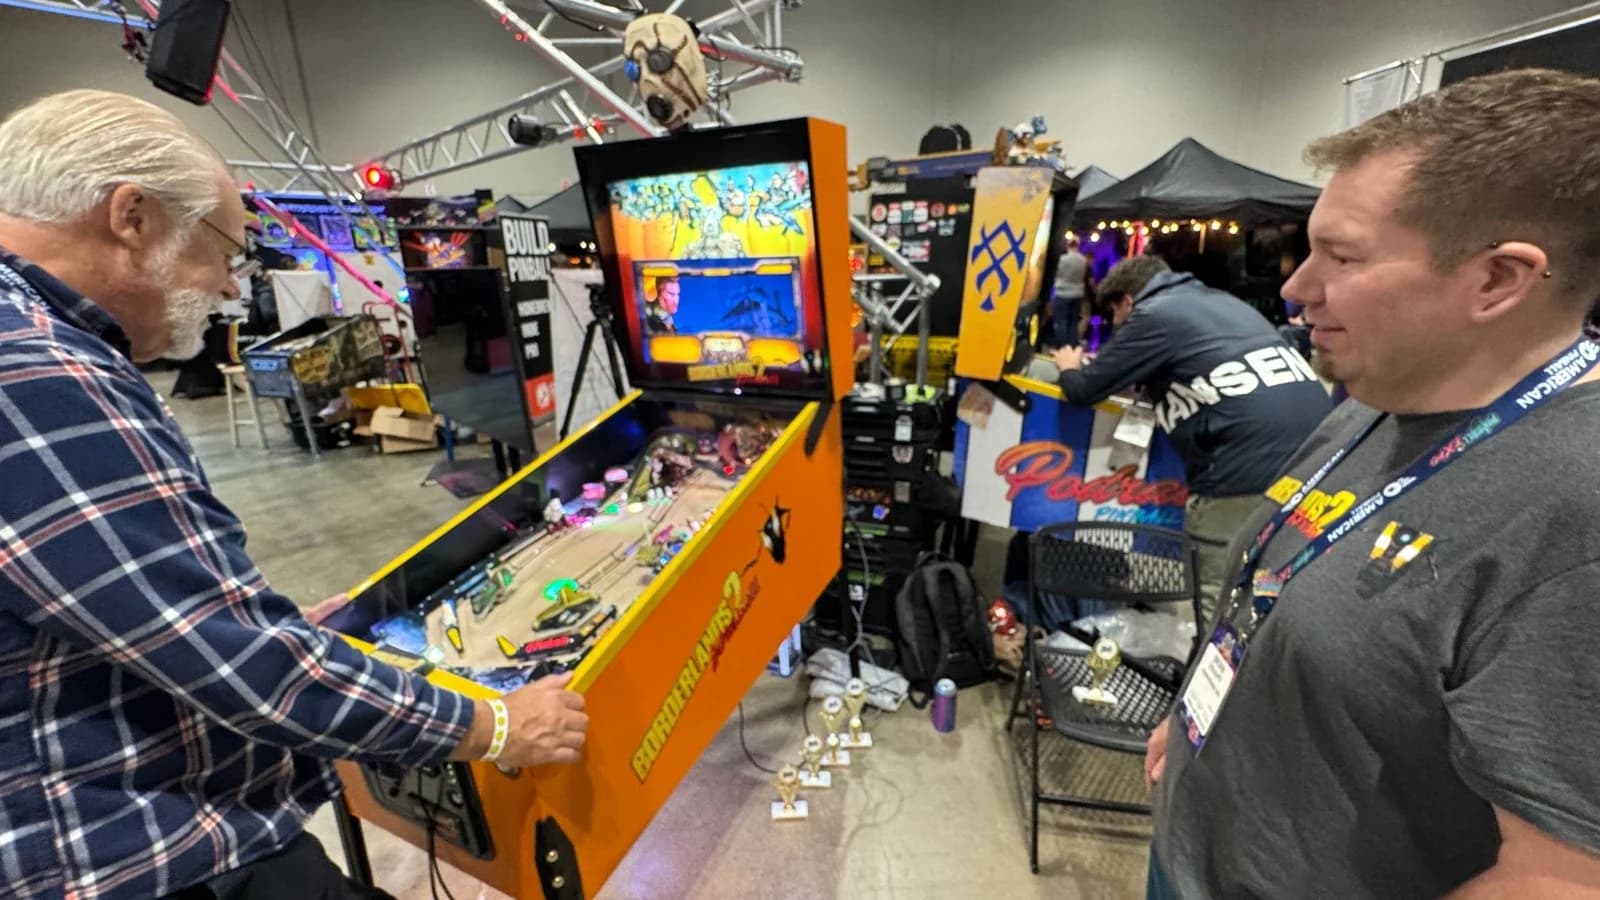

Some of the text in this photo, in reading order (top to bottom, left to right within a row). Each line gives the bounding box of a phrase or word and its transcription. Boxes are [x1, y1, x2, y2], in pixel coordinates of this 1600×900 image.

[501, 217, 549, 255] BUILD
[1516, 356, 1587, 409] AMERICAN
[1327, 498, 1384, 542] AMERICAN
[723, 569, 742, 611] 2
